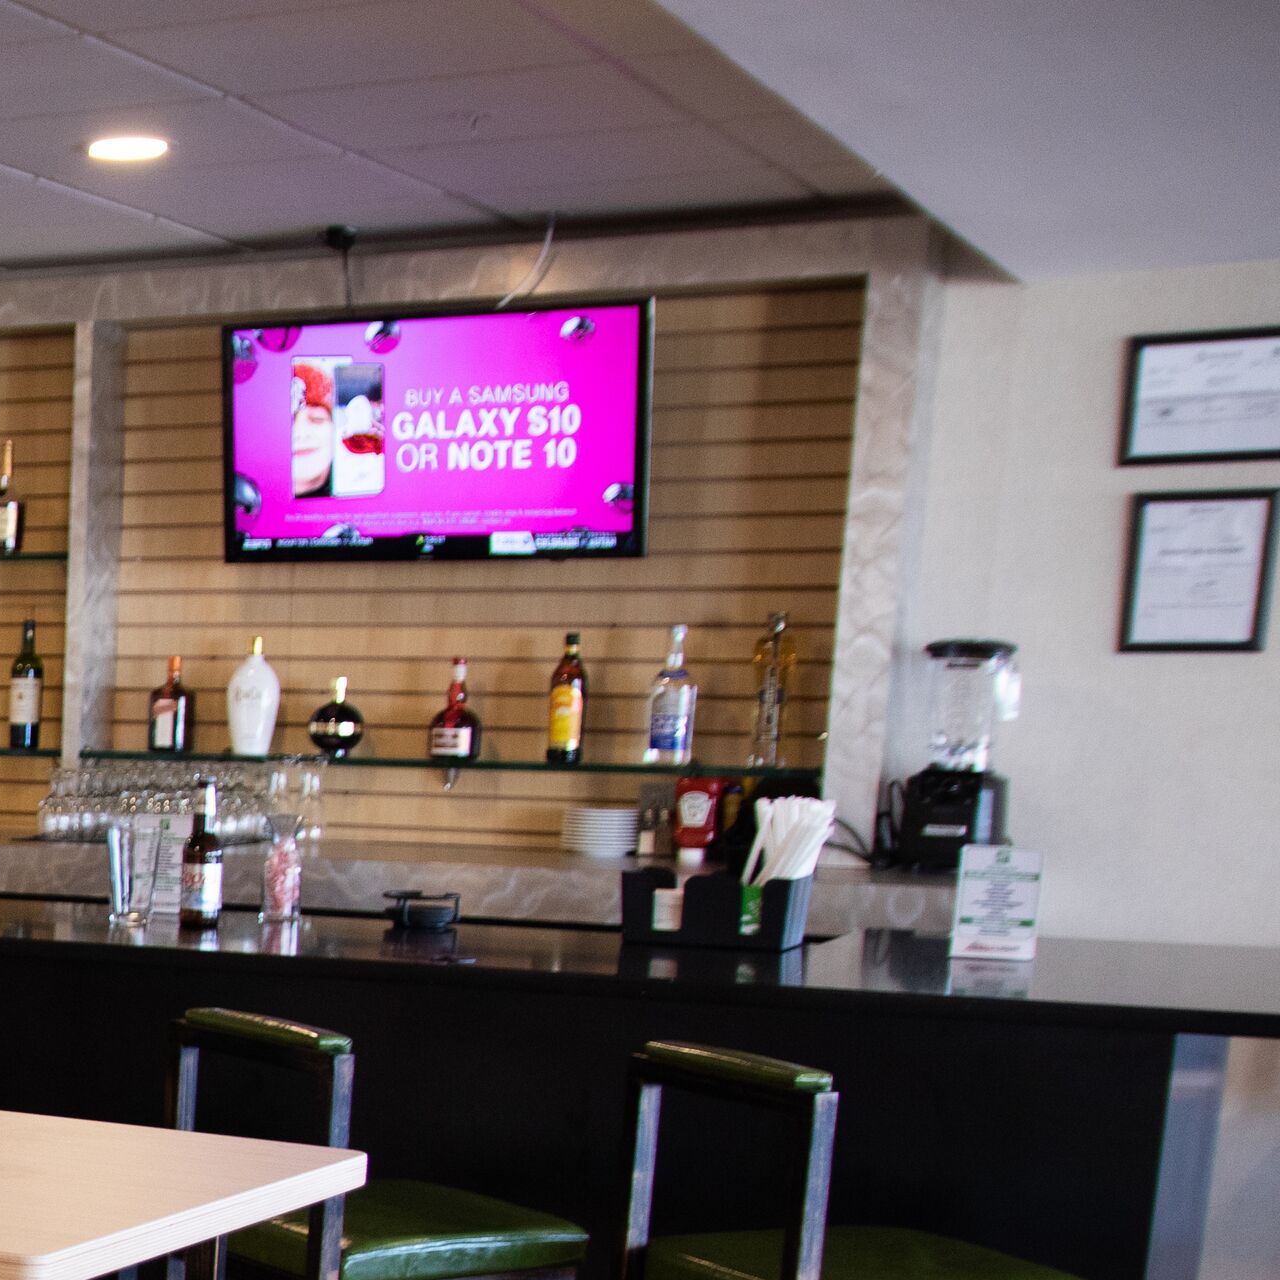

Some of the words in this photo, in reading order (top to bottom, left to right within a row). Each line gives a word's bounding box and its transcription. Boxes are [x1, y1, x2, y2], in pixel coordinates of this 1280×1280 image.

[404, 388, 443, 407] BUY
[448, 387, 462, 404] A
[468, 381, 570, 404] SAMSUNG
[392, 407, 521, 440] GALAXY
[526, 404, 582, 436] S10
[396, 442, 438, 472] OR
[448, 439, 532, 471] NOTE
[543, 437, 576, 469] 10
